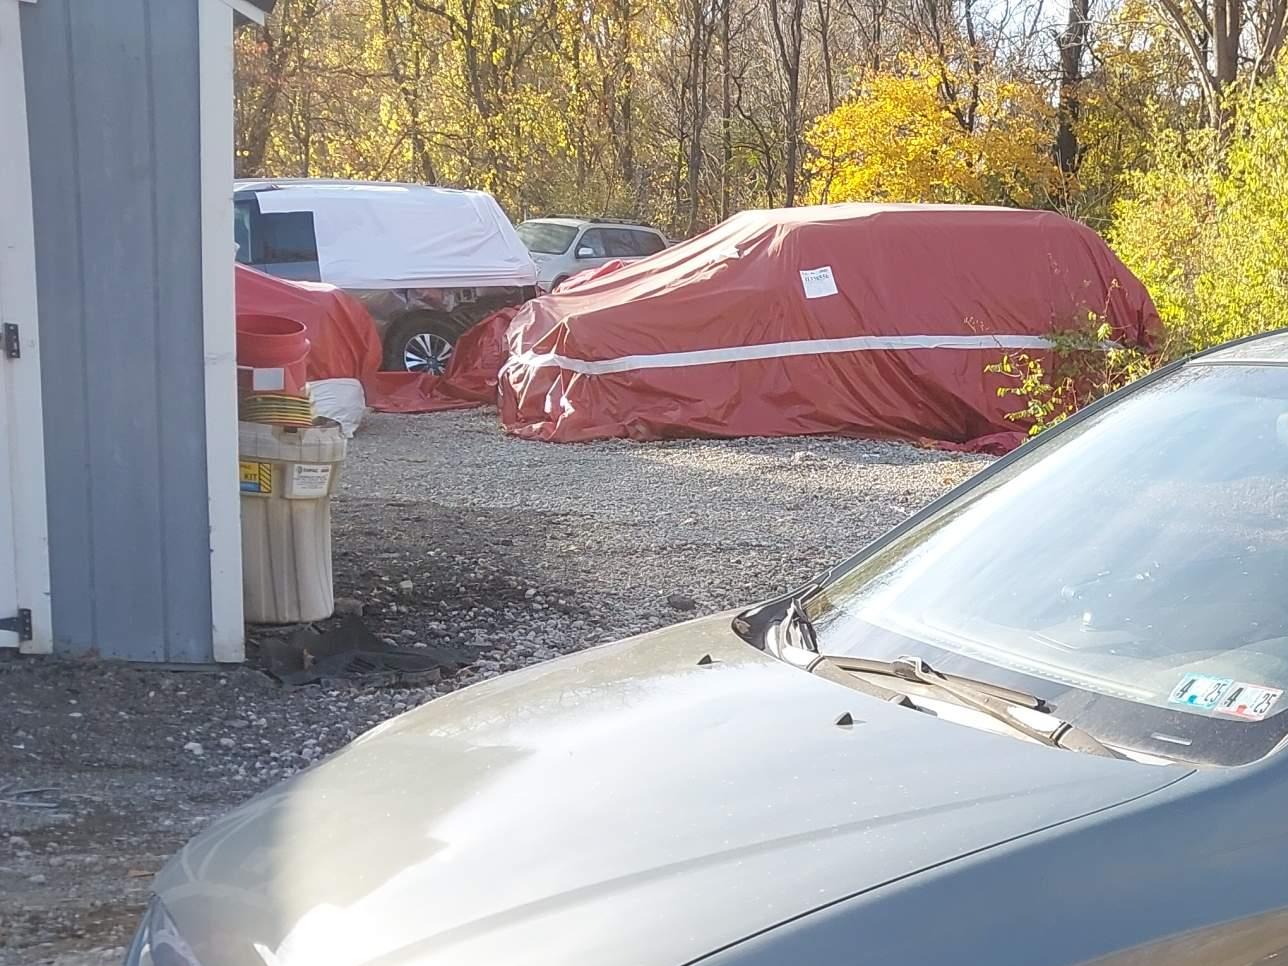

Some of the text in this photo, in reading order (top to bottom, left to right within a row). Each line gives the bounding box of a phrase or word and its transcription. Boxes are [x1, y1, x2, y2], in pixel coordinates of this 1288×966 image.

[1176, 679, 1227, 702] 4 25
[1224, 687, 1277, 713] 4 25
